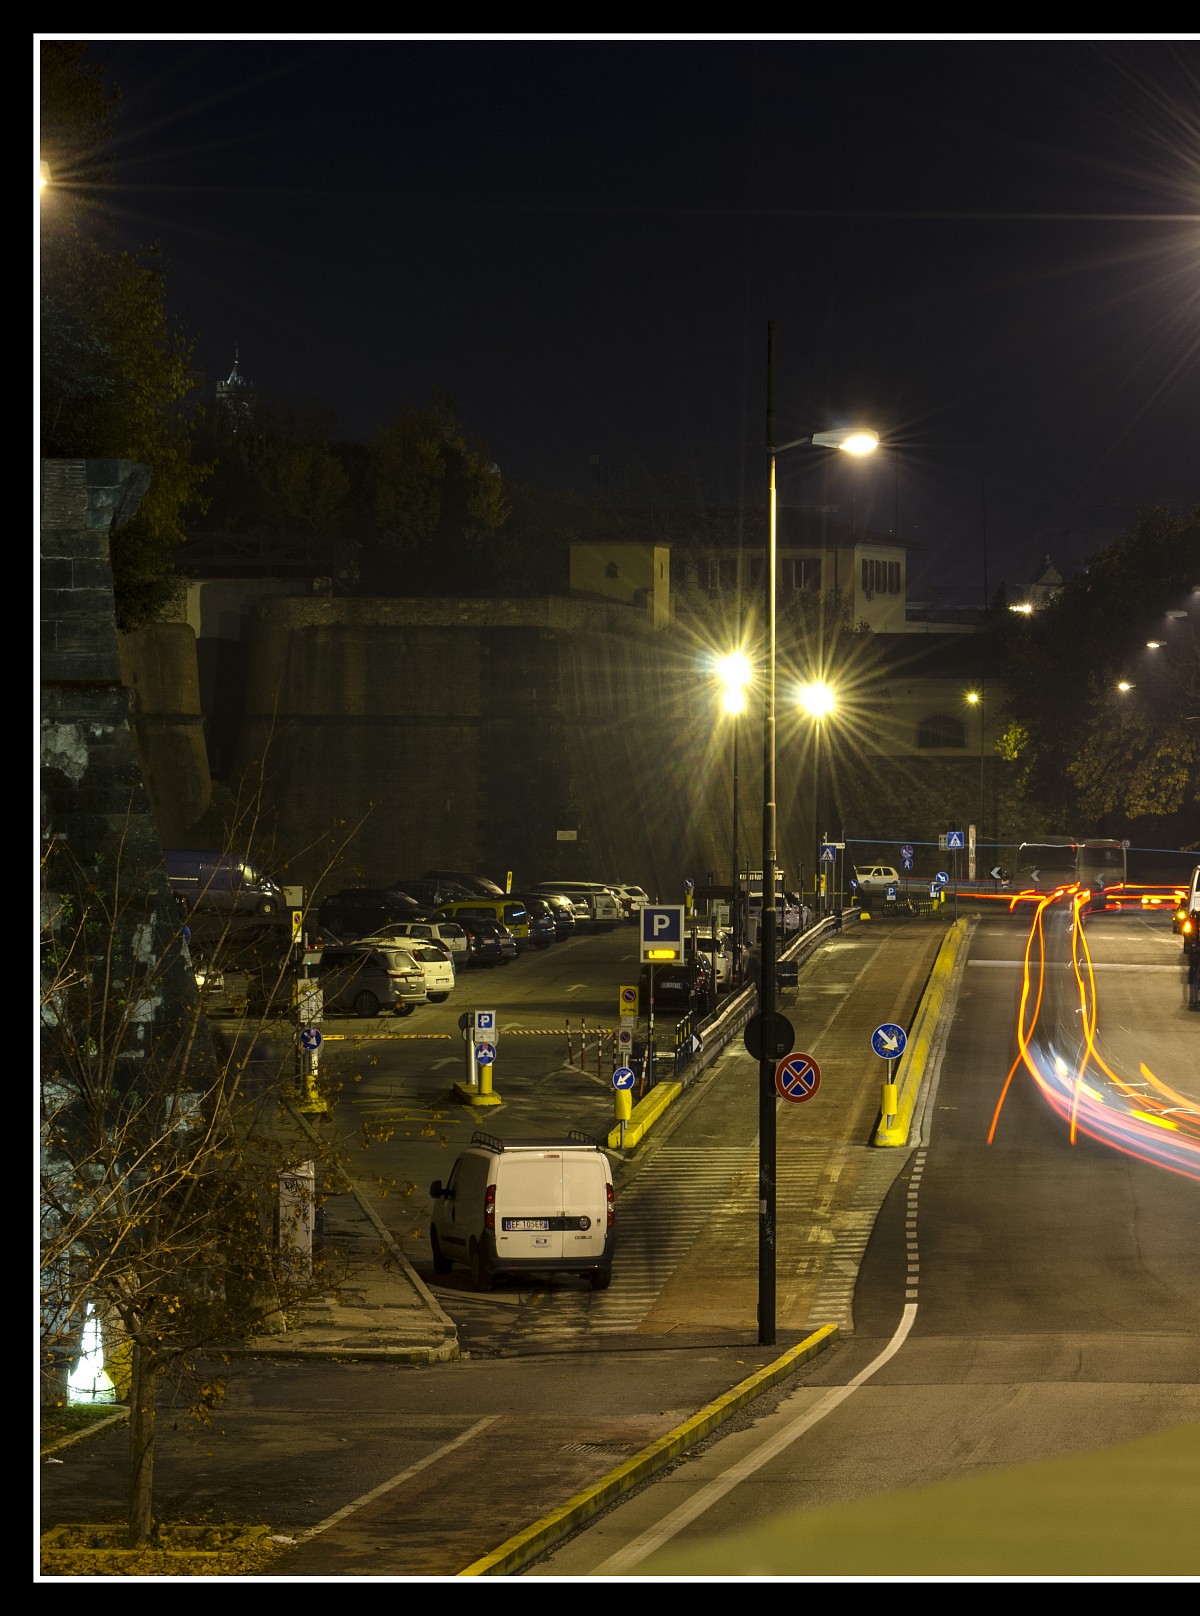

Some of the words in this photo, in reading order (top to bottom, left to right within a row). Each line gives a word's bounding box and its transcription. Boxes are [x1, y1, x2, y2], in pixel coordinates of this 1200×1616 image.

[888, 887, 895, 895] P
[653, 914, 671, 937] P
[480, 1015, 490, 1027] P
[511, 1220, 520, 1229] EF
